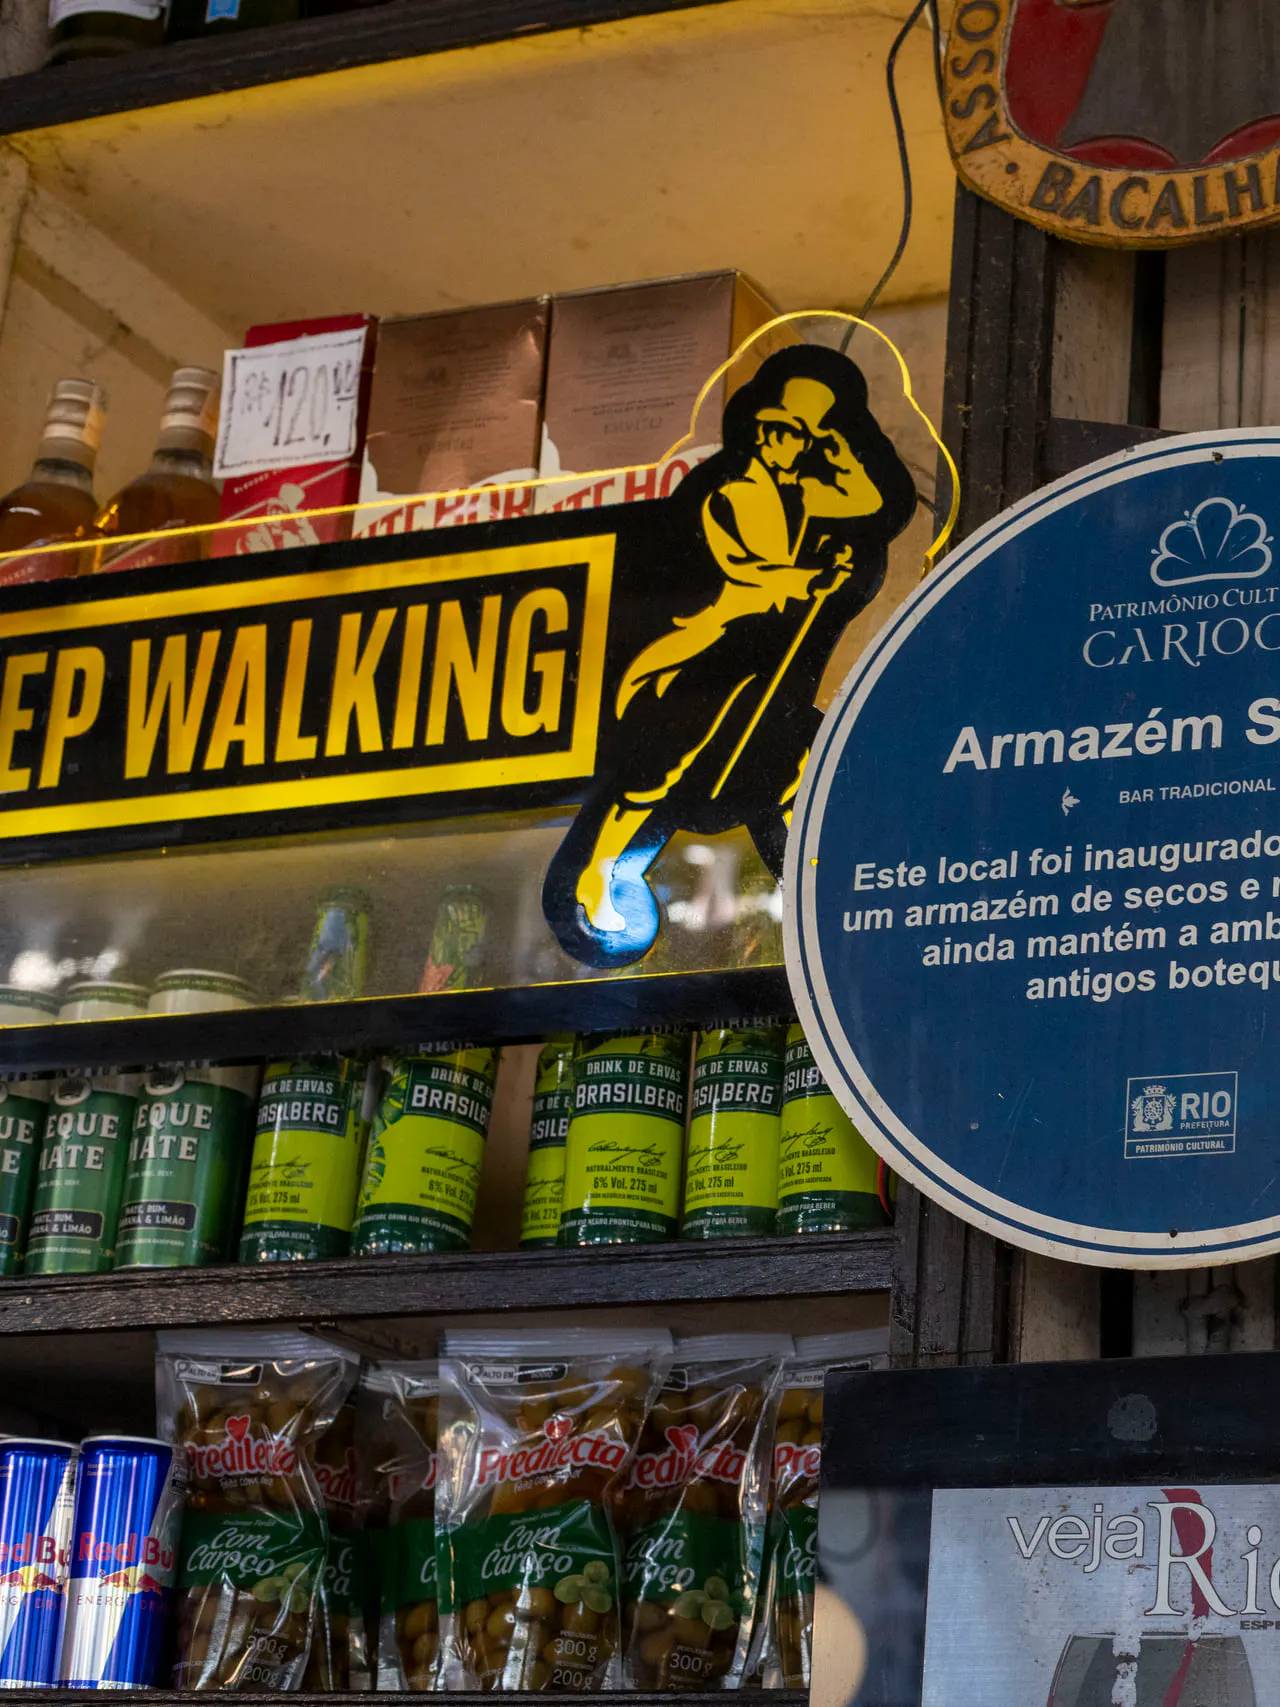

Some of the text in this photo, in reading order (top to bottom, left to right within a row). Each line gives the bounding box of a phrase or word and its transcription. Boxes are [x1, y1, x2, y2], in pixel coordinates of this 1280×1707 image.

[1089, 593, 1220, 622] PATRIMÔNIO
[123, 586, 570, 780] WALKING
[942, 707, 1223, 774] Armazém
[1118, 778, 1276, 804] BAR TRADICIONAL
[853, 861, 927, 891] Este
[938, 850, 1018, 884] local
[1028, 845, 1072, 876] foi
[843, 907, 893, 932] um
[904, 890, 1059, 927] armazém
[1071, 884, 1113, 914] de
[1123, 880, 1228, 909] secos
[1240, 878, 1260, 900] e
[922, 933, 1015, 967] ainda
[1027, 922, 1166, 959] mantém
[1178, 924, 1198, 947] a
[1026, 967, 1156, 1003] antigos
[430, 1067, 469, 1087] DRINK
[587, 1060, 681, 1083] DRINK DE ERVAS
[710, 1060, 769, 1075] DE ERVAS
[279, 1079, 334, 1096] DE ERVAS
[576, 1082, 684, 1115] BRASILBERG
[692, 1082, 775, 1106] ASILBERG
[1180, 1090, 1232, 1121] RIO
[1180, 1120, 1231, 1130] PREFEITURA
[1186, 1140, 1226, 1151] CULTURAL
[586, 1164, 635, 1174] NATURALMENTE
[797, 1161, 823, 1175] 275 ml
[593, 1176, 608, 1189] 6%
[611, 1177, 628, 1190] Vol.
[630, 1178, 647, 1192] 275
[708, 1176, 735, 1189] 275 ml
[272, 1191, 288, 1205] 275
[61, 1223, 93, 1234] LIMÃO
[155, 1215, 186, 1226] LIMÃO
[482, 1369, 502, 1379] ALTO
[478, 1431, 627, 1486] Predilecta
[78, 1532, 138, 1562] Red
[210, 1526, 271, 1550] Com
[1008, 1503, 1145, 1574] veja
[186, 1543, 276, 1579] Caroço
